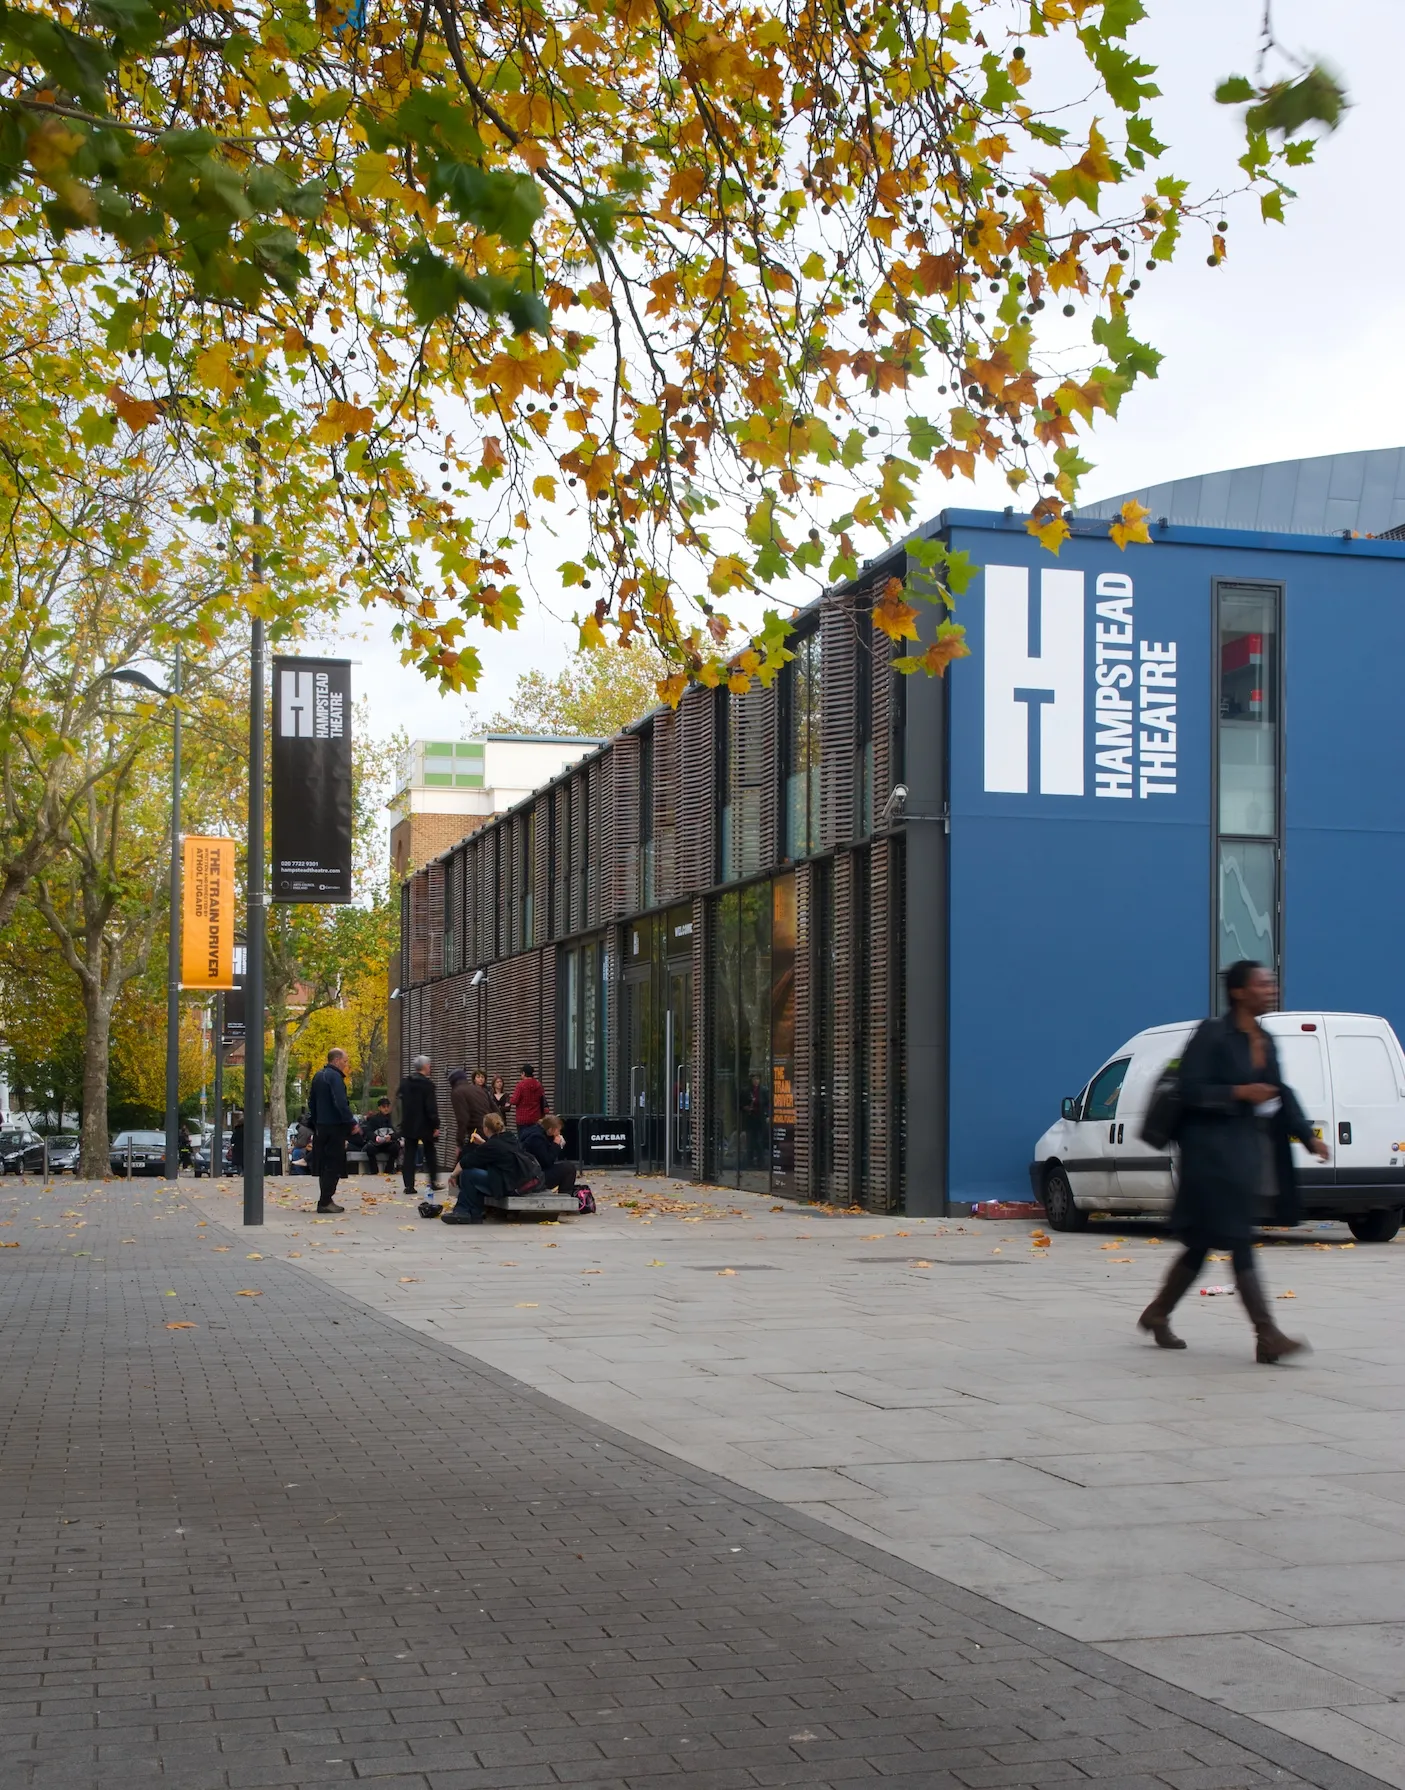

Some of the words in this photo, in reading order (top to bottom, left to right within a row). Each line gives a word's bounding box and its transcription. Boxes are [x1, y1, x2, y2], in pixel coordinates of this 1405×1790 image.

[316, 673, 329, 738] HAMPSTEAD
[1095, 572, 1134, 799] HAMPSTEAD
[330, 692, 343, 738] THEATRE
[1139, 640, 1177, 799] THEATRE
[210, 849, 220, 875] THE
[195, 879, 203, 917] FUGARD
[209, 879, 220, 922] TRAIN
[208, 926, 219, 978] DRIVER
[774, 1066, 785, 1080] THE
[774, 1080, 791, 1093] TRAIN
